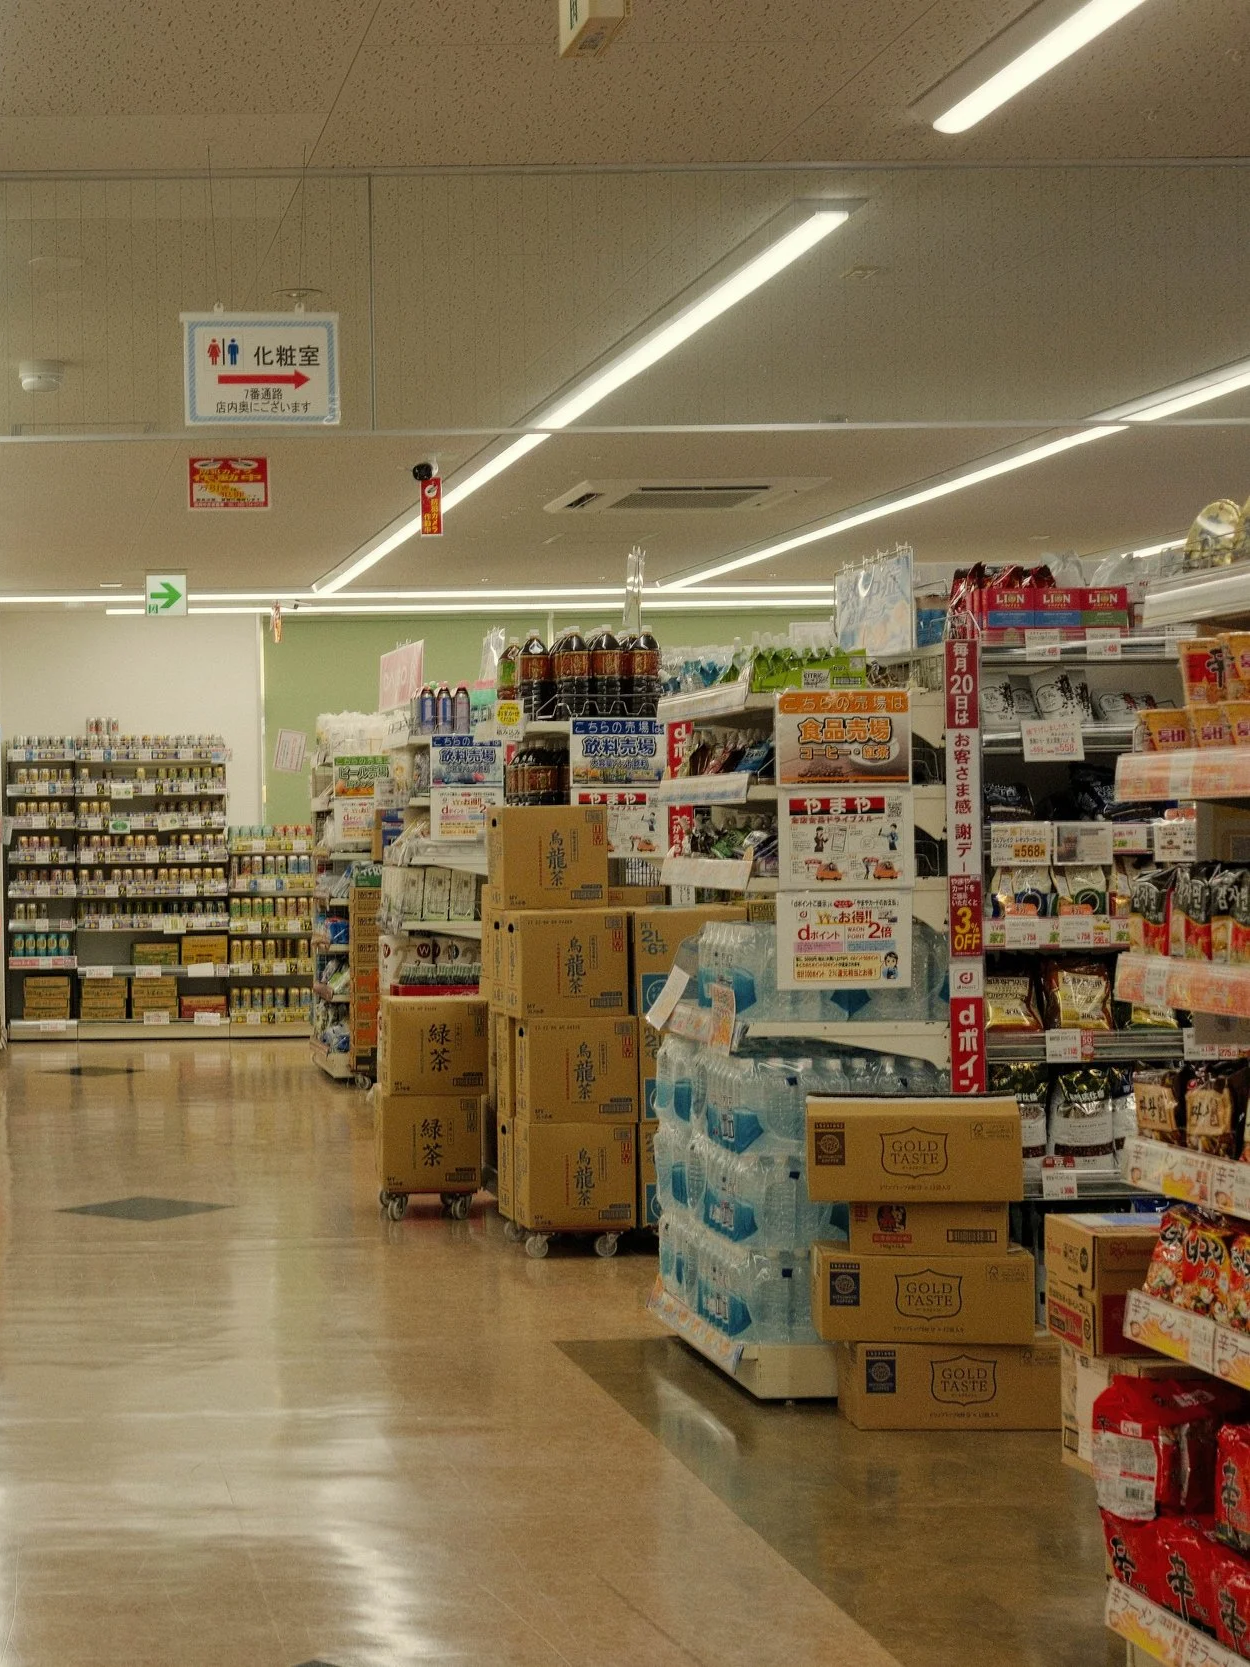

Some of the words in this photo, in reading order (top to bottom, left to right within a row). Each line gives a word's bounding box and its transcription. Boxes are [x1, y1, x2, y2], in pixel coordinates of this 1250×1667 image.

[253, 346, 321, 367] 化粧室
[243, 388, 283, 400] 7番通路
[215, 401, 311, 414] 店内奥にございます
[431, 498, 439, 533] 防犯カメラ
[996, 594, 1025, 603] LION
[1043, 594, 1071, 603] LION
[1088, 593, 1118, 603] LION
[950, 642, 974, 726] 毎月20日は
[784, 695, 904, 712] こちらの売場は
[575, 721, 664, 734] こちらの売場は
[798, 717, 893, 743] 食品売場
[433, 736, 501, 747] こちらのは
[582, 736, 657, 757] 飲料売場
[439, 748, 497, 764] 飲料売場
[800, 745, 891, 760] コーヒー・紅茶
[588, 792, 637, 805] やまや
[803, 796, 871, 814] やまや
[954, 733, 972, 873] お客さま感謝デー
[546, 829, 568, 887] 烏龍茶
[955, 907, 980, 934] 3%
[641, 930, 664, 943] 2L
[797, 923, 841, 941] dポイント
[867, 922, 893, 939] 2倍
[954, 934, 981, 951] OFF
[564, 936, 586, 994] 烏龍茶
[428, 1023, 452, 1072] 緑茶
[574, 1041, 596, 1100] 烏龍茶
[420, 1118, 444, 1168] 緑茶
[891, 1140, 939, 1151] GOLD
[891, 1153, 939, 1165] TASTE
[573, 1147, 596, 1206] 烏龍茶
[906, 1282, 953, 1294] GOLD
[905, 1295, 953, 1306] TASTE
[941, 1367, 988, 1379] GOLD
[940, 1381, 988, 1392] TASTE
